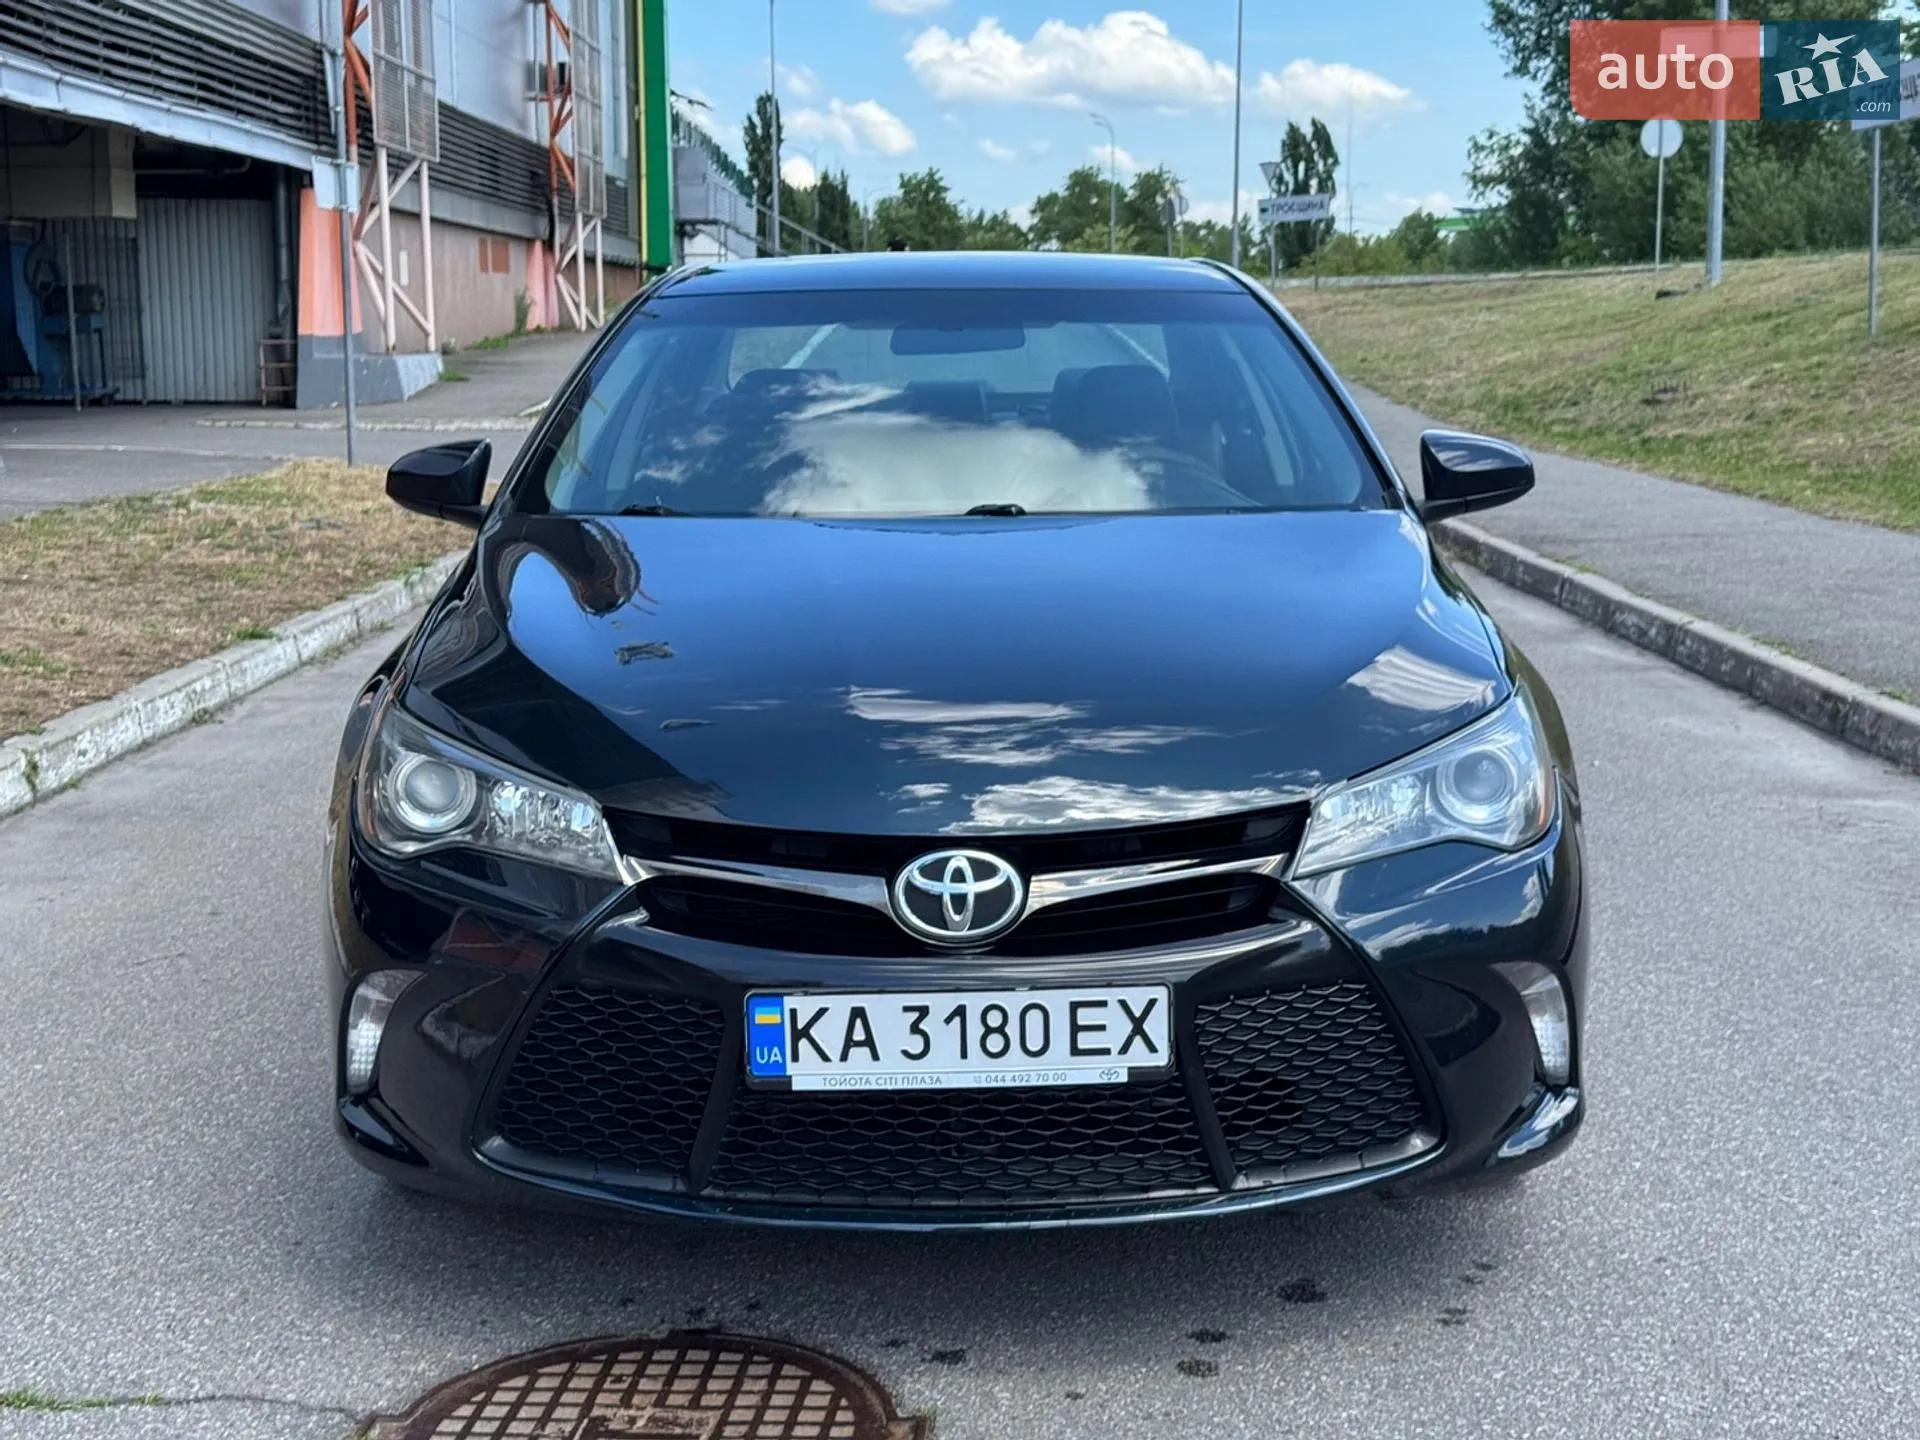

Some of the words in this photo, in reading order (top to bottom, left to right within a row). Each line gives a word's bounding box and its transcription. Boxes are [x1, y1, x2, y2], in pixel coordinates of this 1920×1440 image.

[789, 1006, 880, 1063] KA
[900, 1001, 1051, 1061] 3180
[1069, 998, 1159, 1057] EX
[756, 1046, 783, 1064] UA
[901, 1075, 943, 1085] ПЛАЗА
[985, 1074, 1006, 1084] 044
[1009, 1073, 1032, 1083] 492
[1036, 1072, 1049, 1082] 70
[1052, 1072, 1067, 1082] 00
